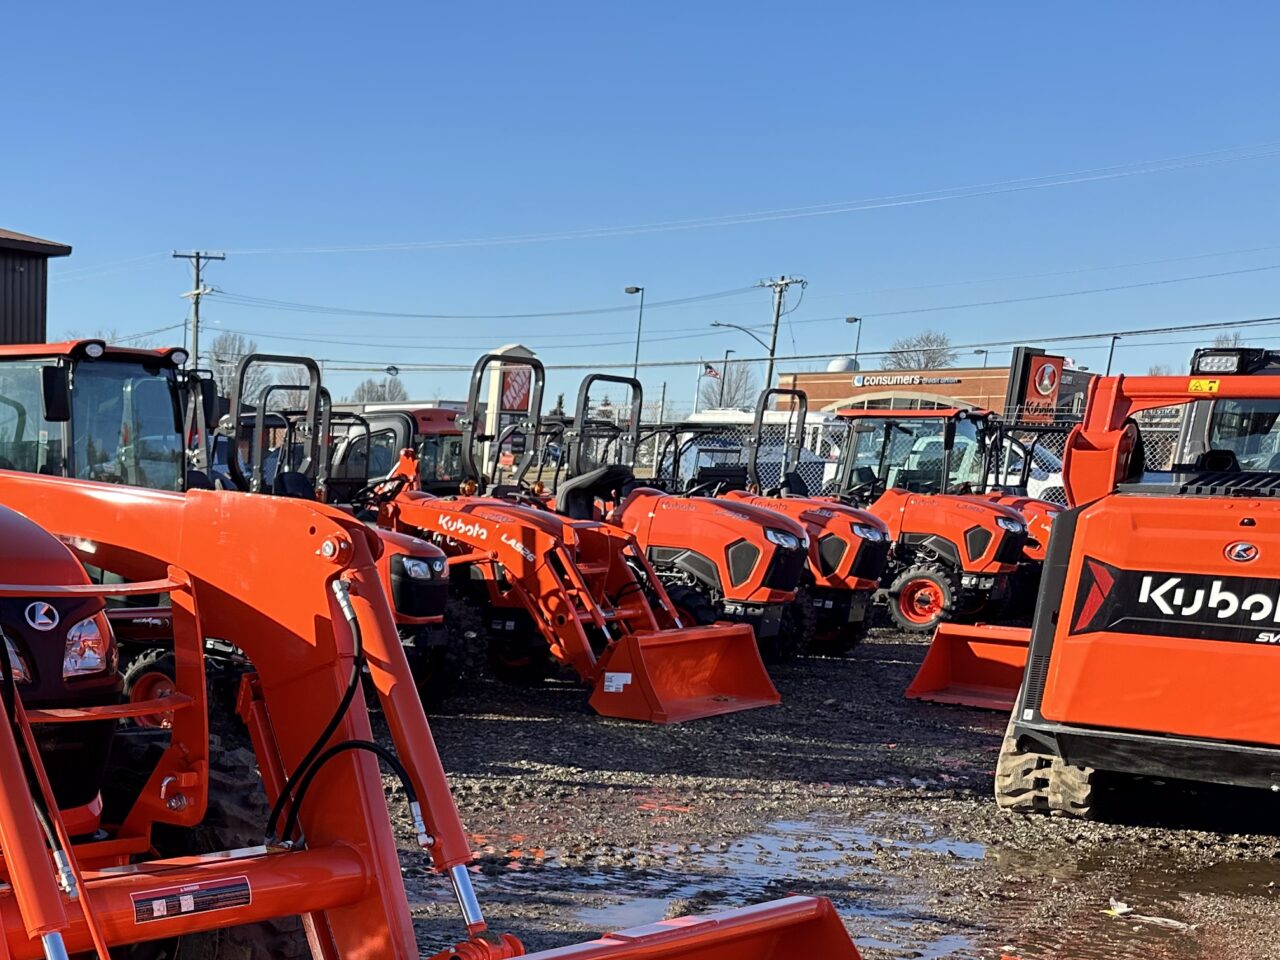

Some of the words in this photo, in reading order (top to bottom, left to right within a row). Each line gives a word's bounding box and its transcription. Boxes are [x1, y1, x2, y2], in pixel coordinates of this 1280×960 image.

[863, 374, 920, 387] consumers
[437, 513, 488, 540] Kubota
[501, 532, 537, 563] LA526
[1138, 576, 1280, 623] Kubo
[1255, 632, 1280, 643] SV
